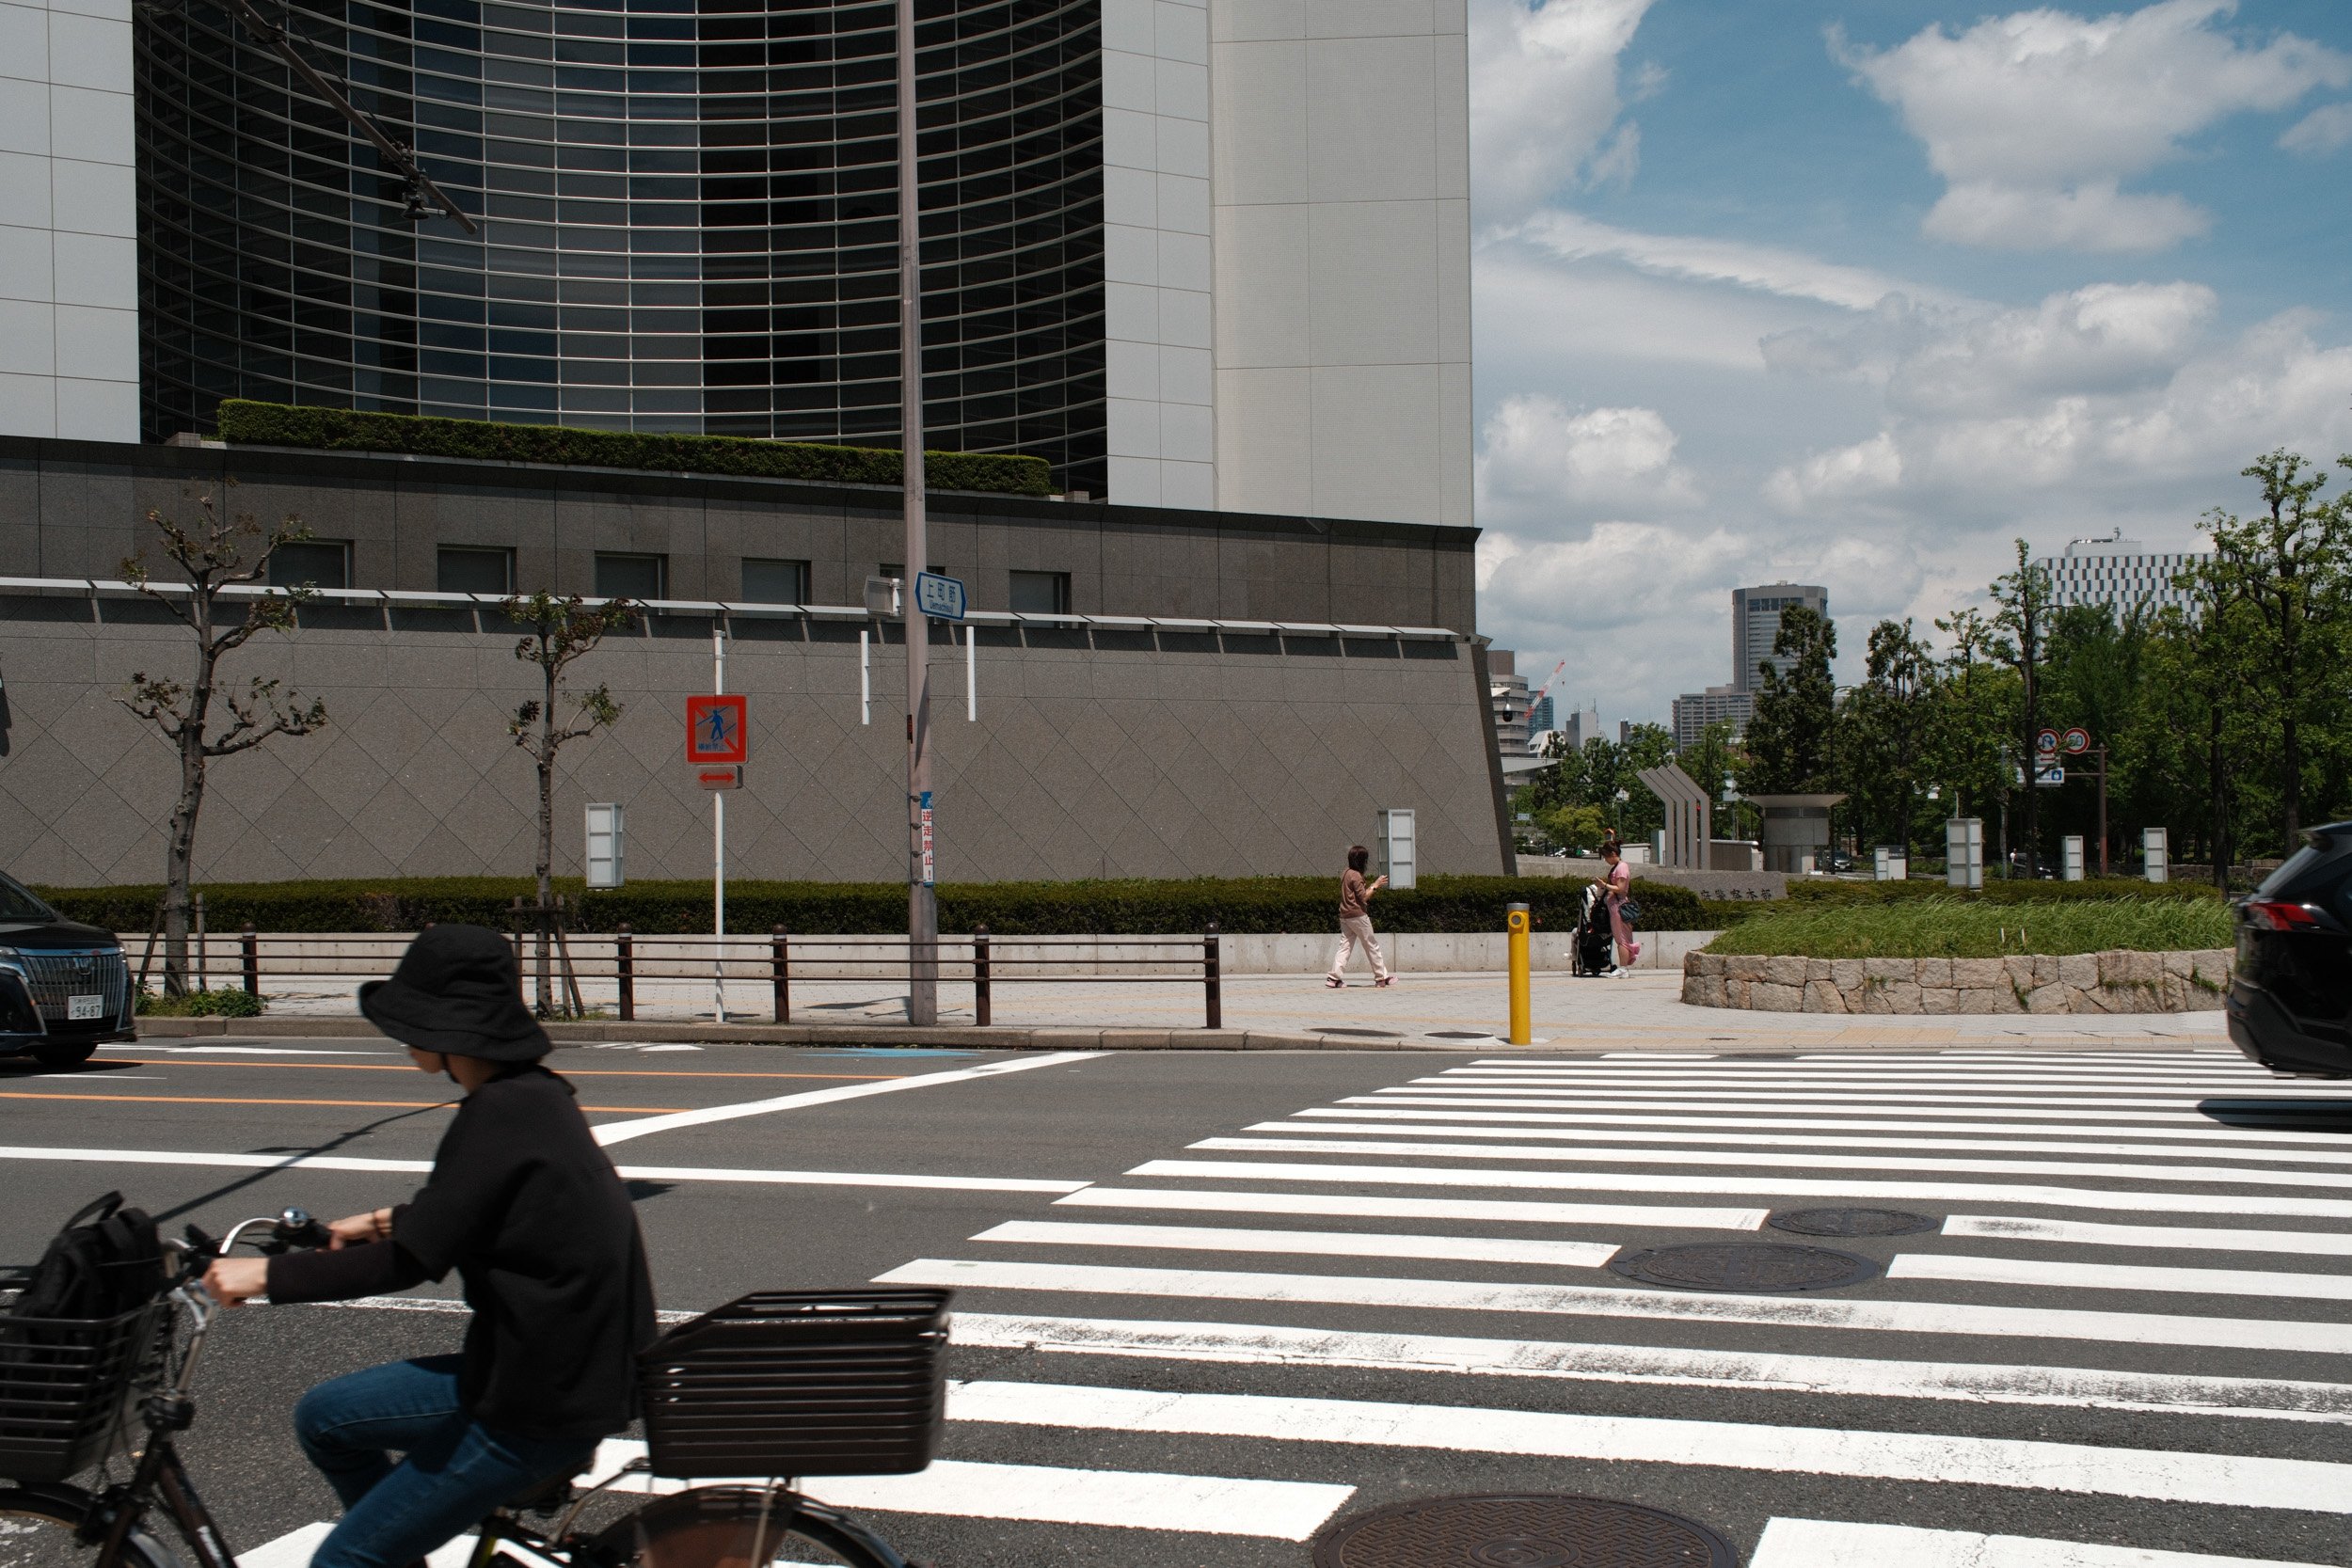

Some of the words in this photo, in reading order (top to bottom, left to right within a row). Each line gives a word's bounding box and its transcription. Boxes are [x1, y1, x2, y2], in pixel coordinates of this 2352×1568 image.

[927, 580, 956, 603] 上町筋
[2069, 735, 2084, 746] 50
